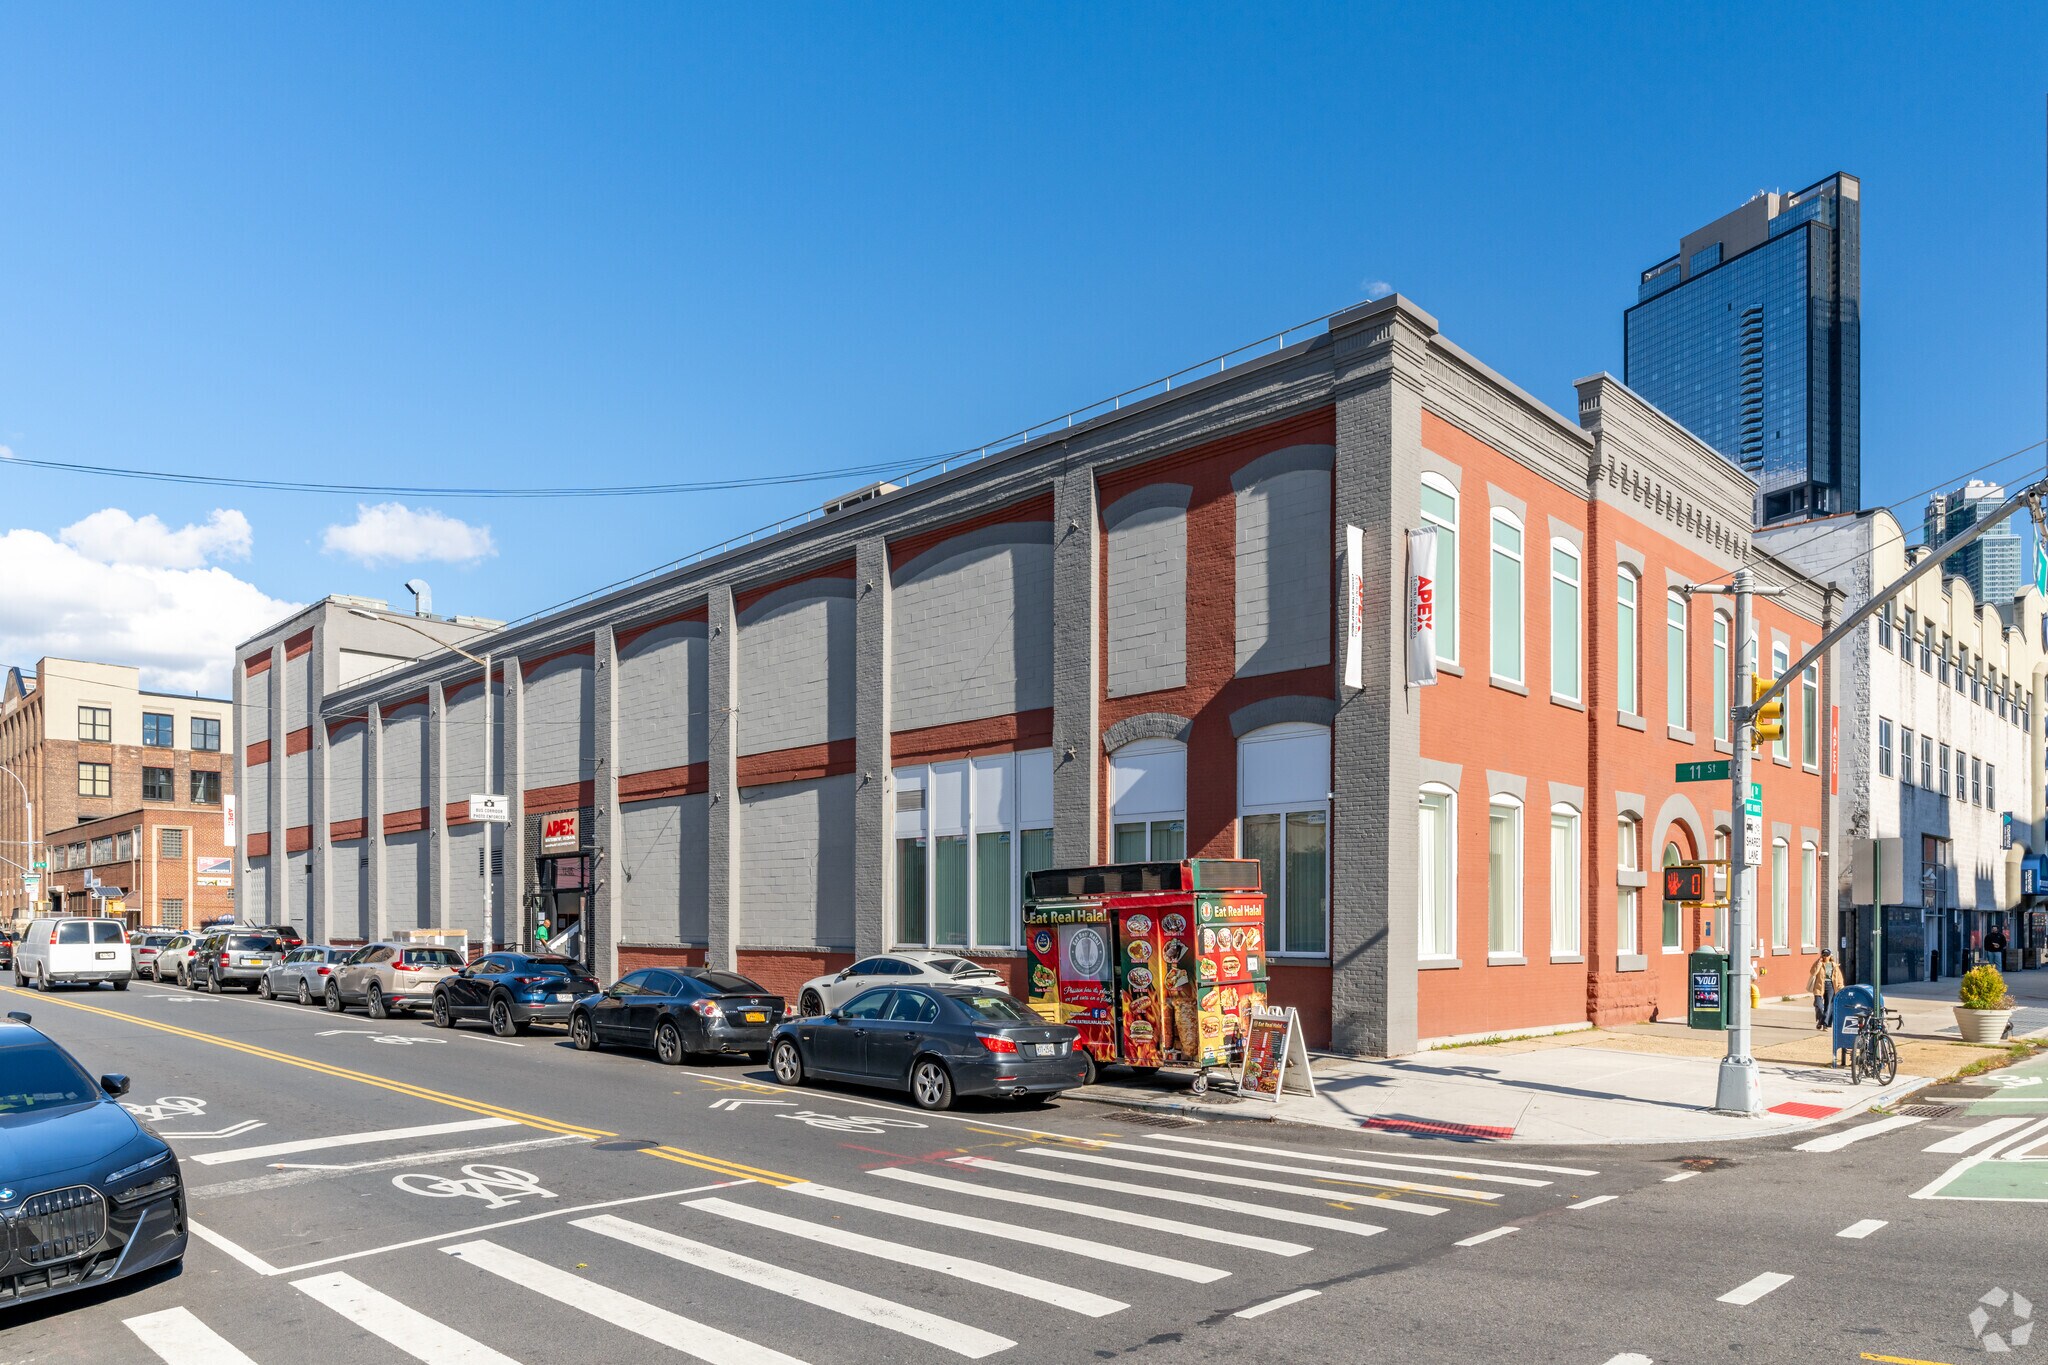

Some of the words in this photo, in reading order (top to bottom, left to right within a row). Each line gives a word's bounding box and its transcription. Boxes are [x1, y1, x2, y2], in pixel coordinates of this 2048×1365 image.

[1417, 575, 1433, 632] APEX
[1689, 765, 1701, 779] 11
[1707, 764, 1716, 773] St
[545, 817, 575, 838] APEX
[1746, 836, 1761, 847] SHARED
[1748, 850, 1759, 860] LANE
[1691, 873, 1701, 895] 0
[1029, 912, 1048, 924] Eat
[1050, 909, 1075, 923] Real
[1077, 908, 1107, 922] Halal
[1214, 905, 1227, 917] Eat
[1228, 905, 1243, 917] Real
[1244, 904, 1262, 916] Halal
[1695, 976, 1717, 985] VOLO
